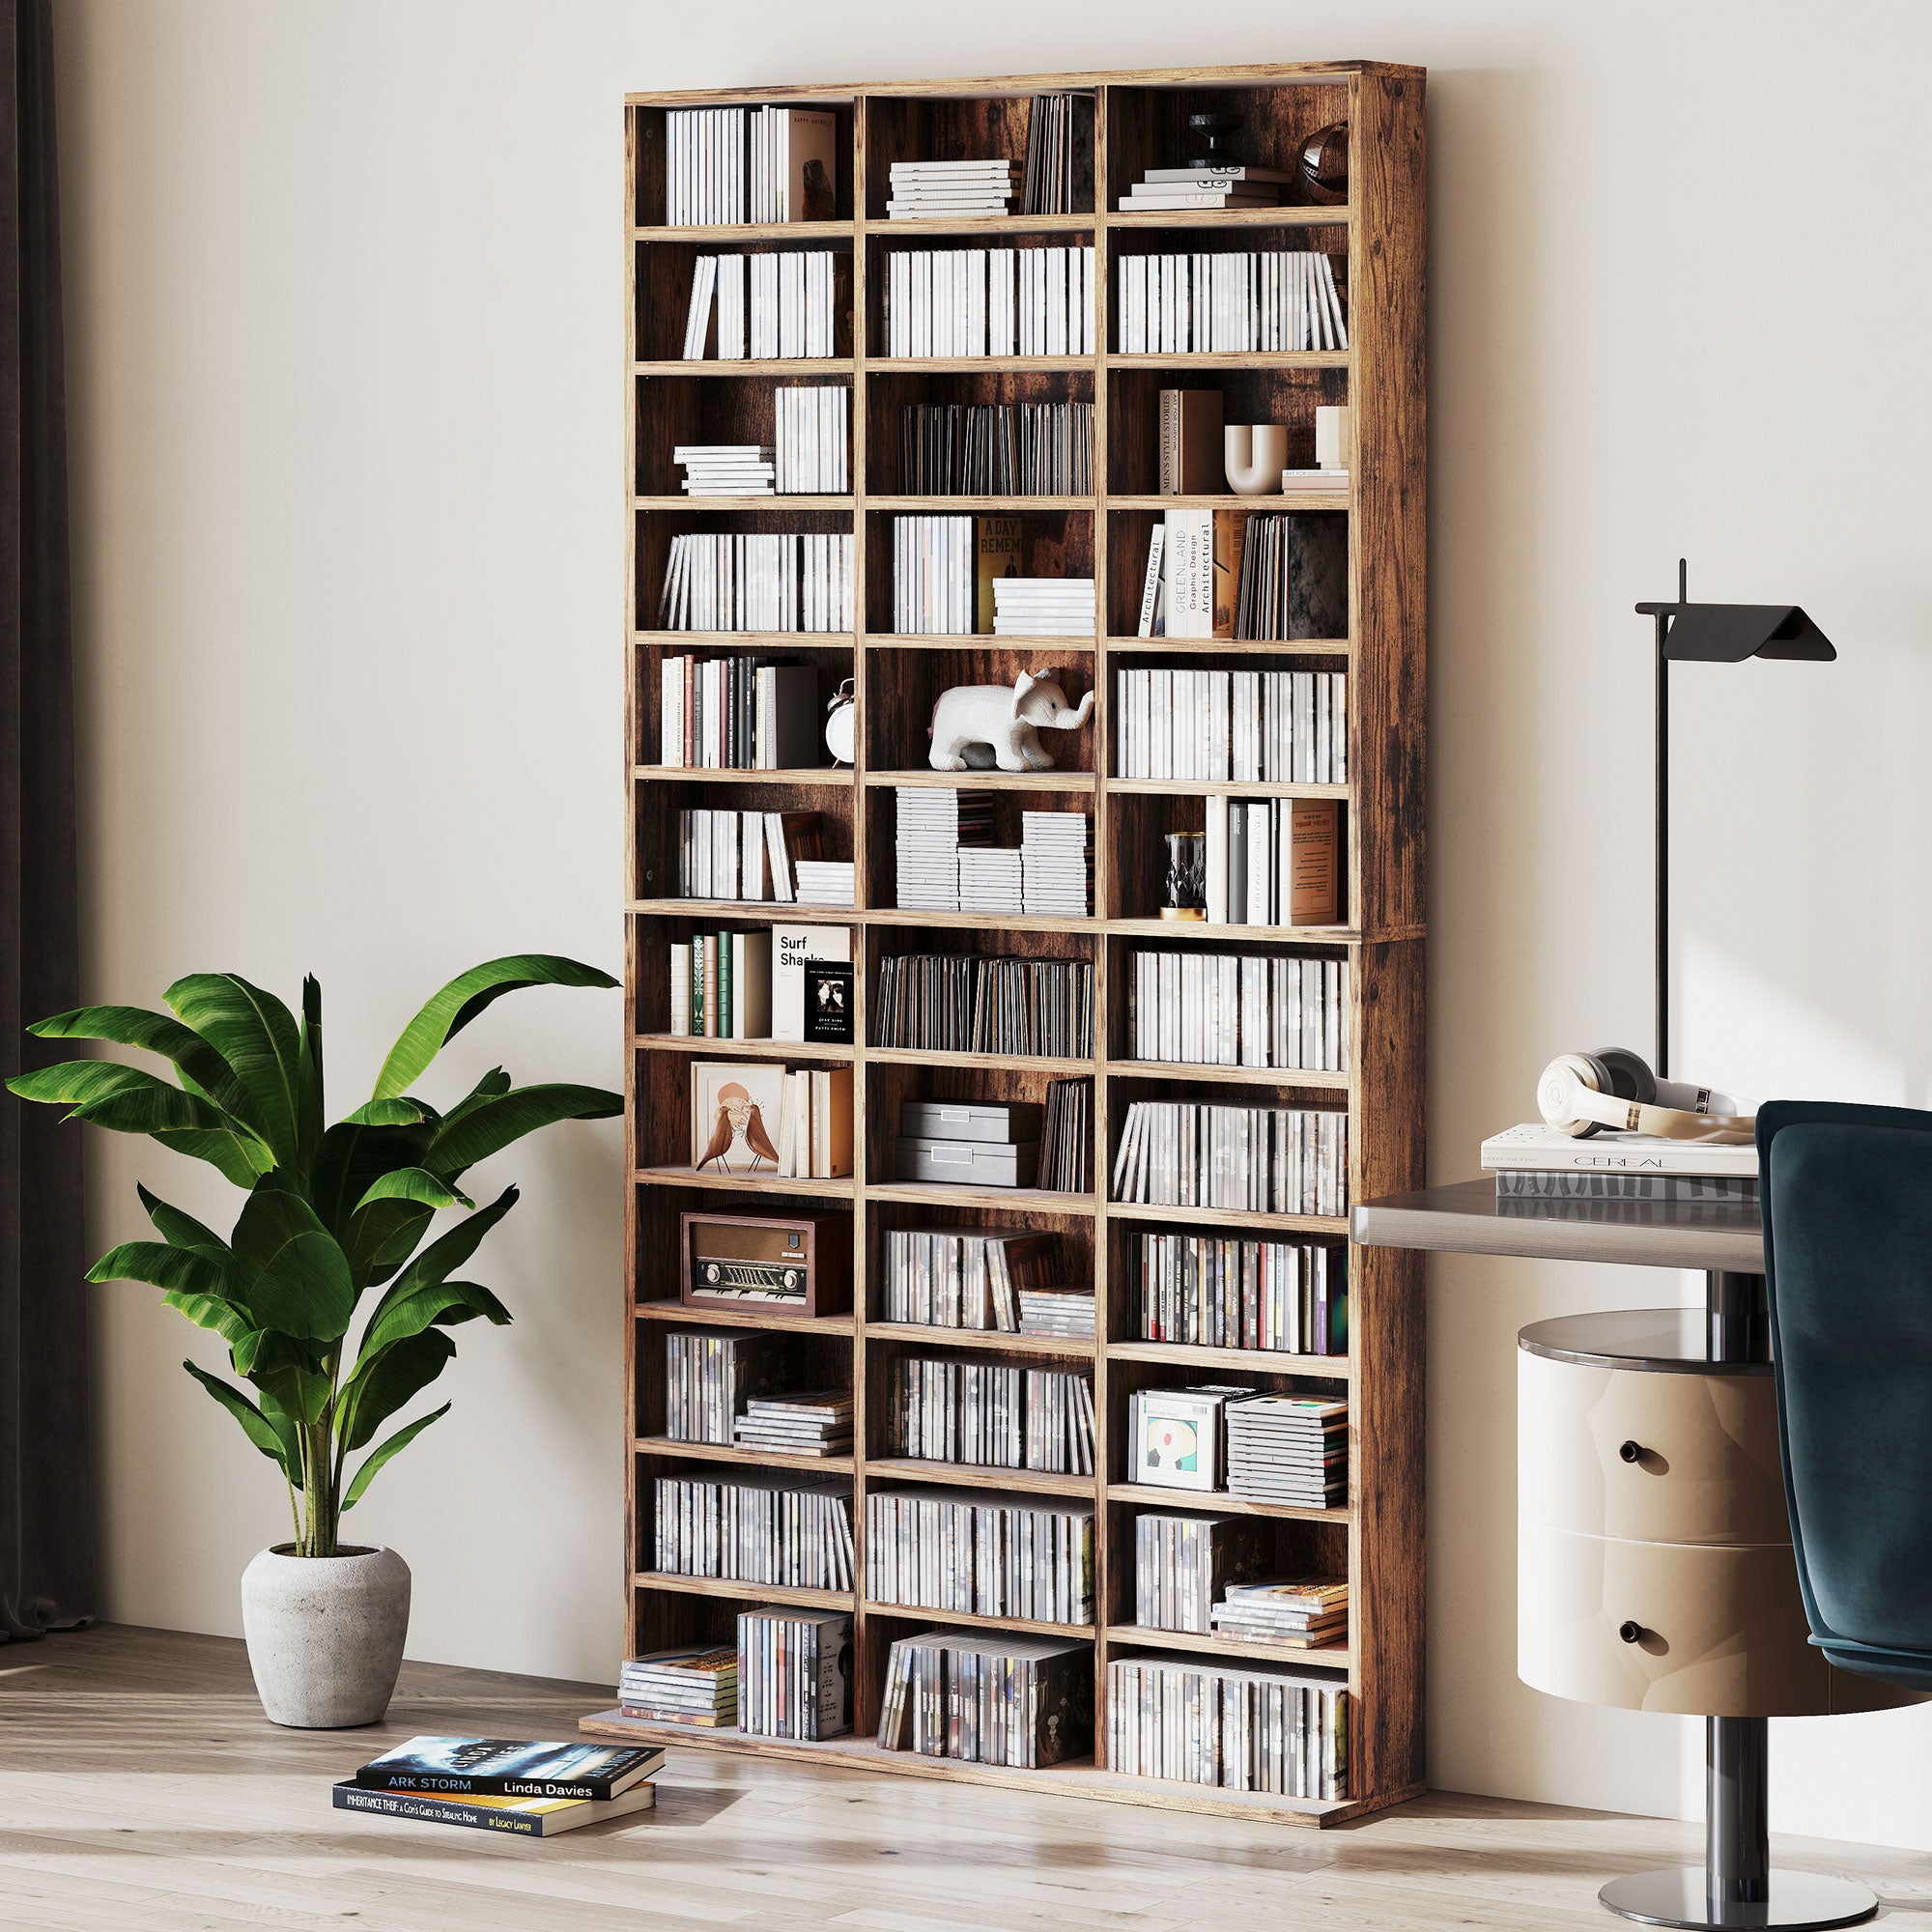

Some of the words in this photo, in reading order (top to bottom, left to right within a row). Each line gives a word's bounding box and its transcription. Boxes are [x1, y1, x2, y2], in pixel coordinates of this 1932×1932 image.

[985, 521, 993, 535] A
[995, 522, 1017, 536] DAY
[980, 539, 1023, 554] REMEM
[1177, 530, 1186, 613] GREENLAND
[1142, 542, 1160, 623] Architectural
[781, 936, 807, 950] Surf
[1574, 1156, 1676, 1169] CEREAL
[450, 1747, 497, 1768] LINDA
[388, 1776, 416, 1787] ARK
[420, 1777, 471, 1790] STORM
[504, 1782, 542, 1795] Linda
[546, 1784, 593, 1797] Davies
[347, 1794, 383, 1809] INHERITANCE
